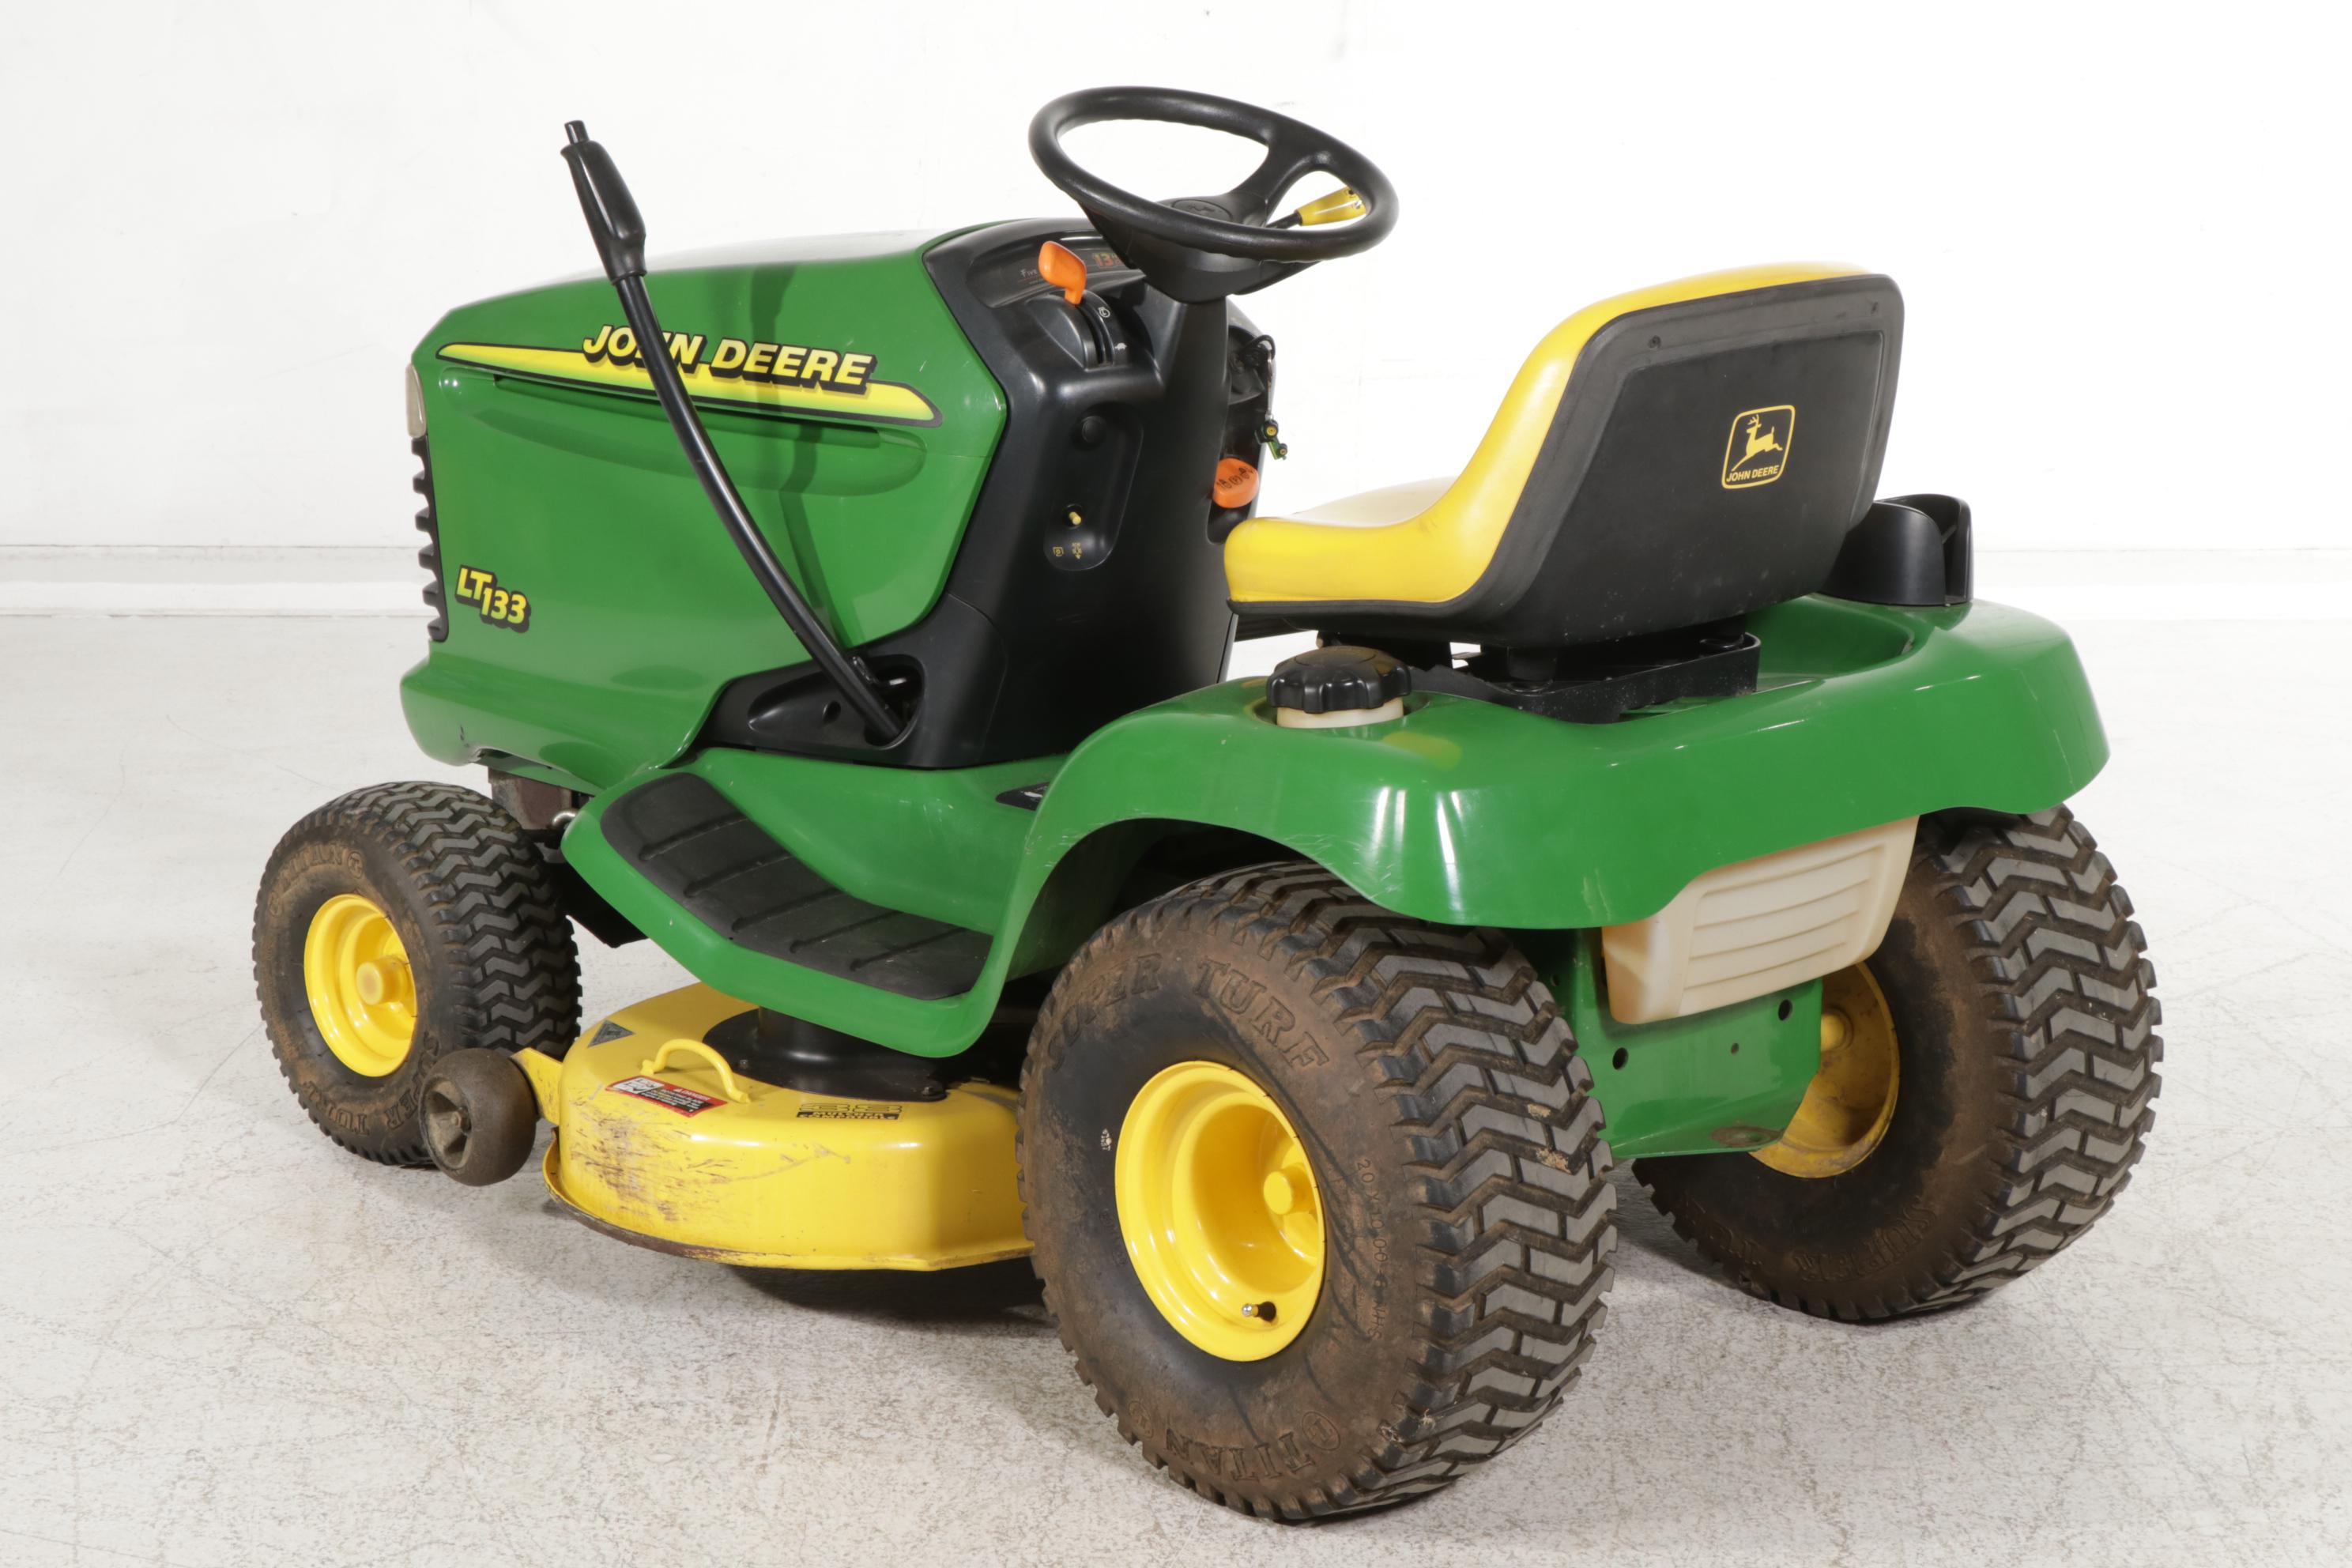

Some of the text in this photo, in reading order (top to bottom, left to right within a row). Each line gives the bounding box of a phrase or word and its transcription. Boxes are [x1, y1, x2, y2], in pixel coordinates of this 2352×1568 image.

[582, 324, 876, 390] JON DEERE
[1726, 464, 1780, 482] JOHN DEERE
[1193, 956, 1329, 1068] TURF
[1356, 1159, 1375, 1184] 20
[1166, 1427, 1316, 1483] TITAN
